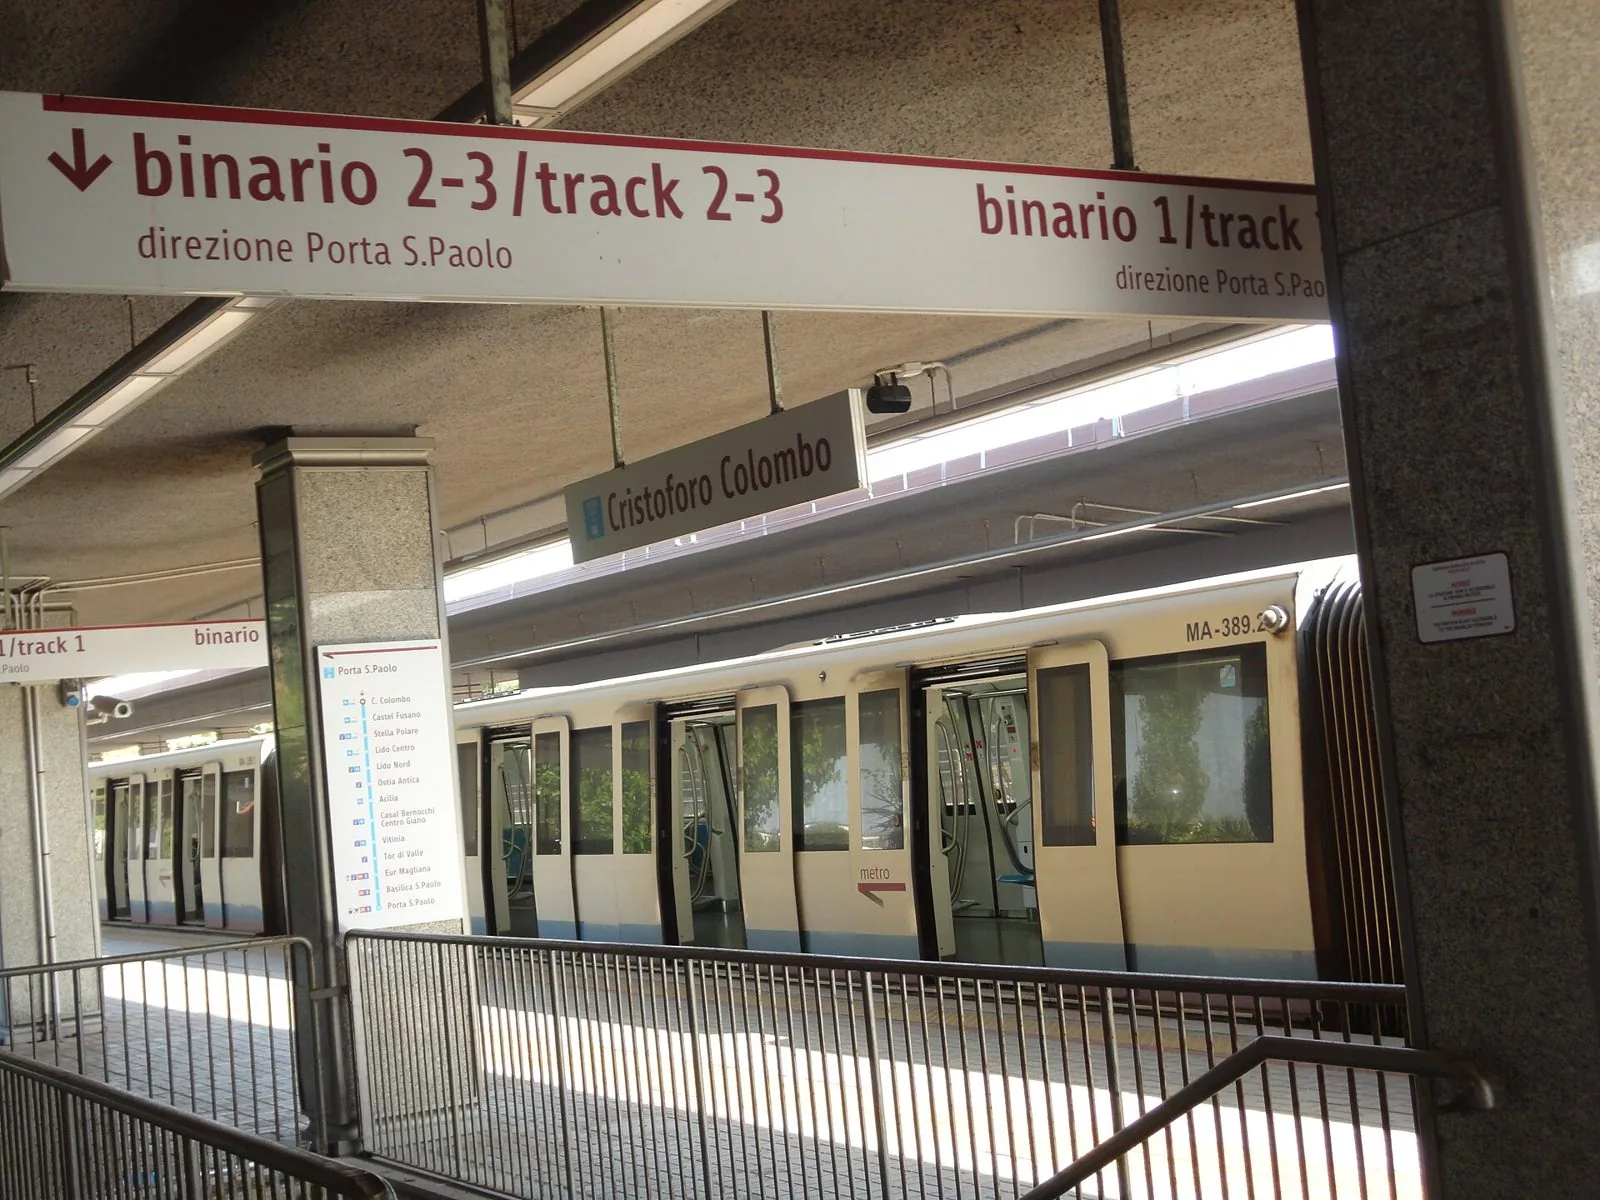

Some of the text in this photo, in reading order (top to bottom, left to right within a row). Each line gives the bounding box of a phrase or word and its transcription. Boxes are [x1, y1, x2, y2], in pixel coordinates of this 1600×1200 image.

[133, 132, 784, 224] binario 2-3/track 2-3
[976, 183, 1303, 251] binario 1/track
[137, 227, 513, 269] direzione Porta S.Paolo
[1116, 265, 1325, 297] direzione Porta S.Pao
[607, 432, 832, 532] Cristoforo Colombo
[195, 627, 259, 646] binario
[74, 634, 85, 652] 1
[338, 663, 398, 676] Porta S.Paolo
[371, 695, 411, 705] C. Colombo
[372, 711, 421, 721] Castel Fusano
[373, 728, 419, 738] Stella Polare
[375, 743, 415, 754] Lido Centro
[376, 760, 411, 770] Lido Nord
[377, 777, 420, 787] Ostia Antica
[379, 794, 399, 803] Acilia
[380, 807, 435, 819] Casal Bernocchi
[381, 816, 426, 828] Centro Giano
[382, 835, 405, 844] Vitinia
[406, 850, 424, 858] Valle
[385, 866, 431, 877] Eur Magliana
[860, 866, 890, 880] metro
[386, 884, 413, 893] Basilica
[387, 900, 407, 910] Porta
